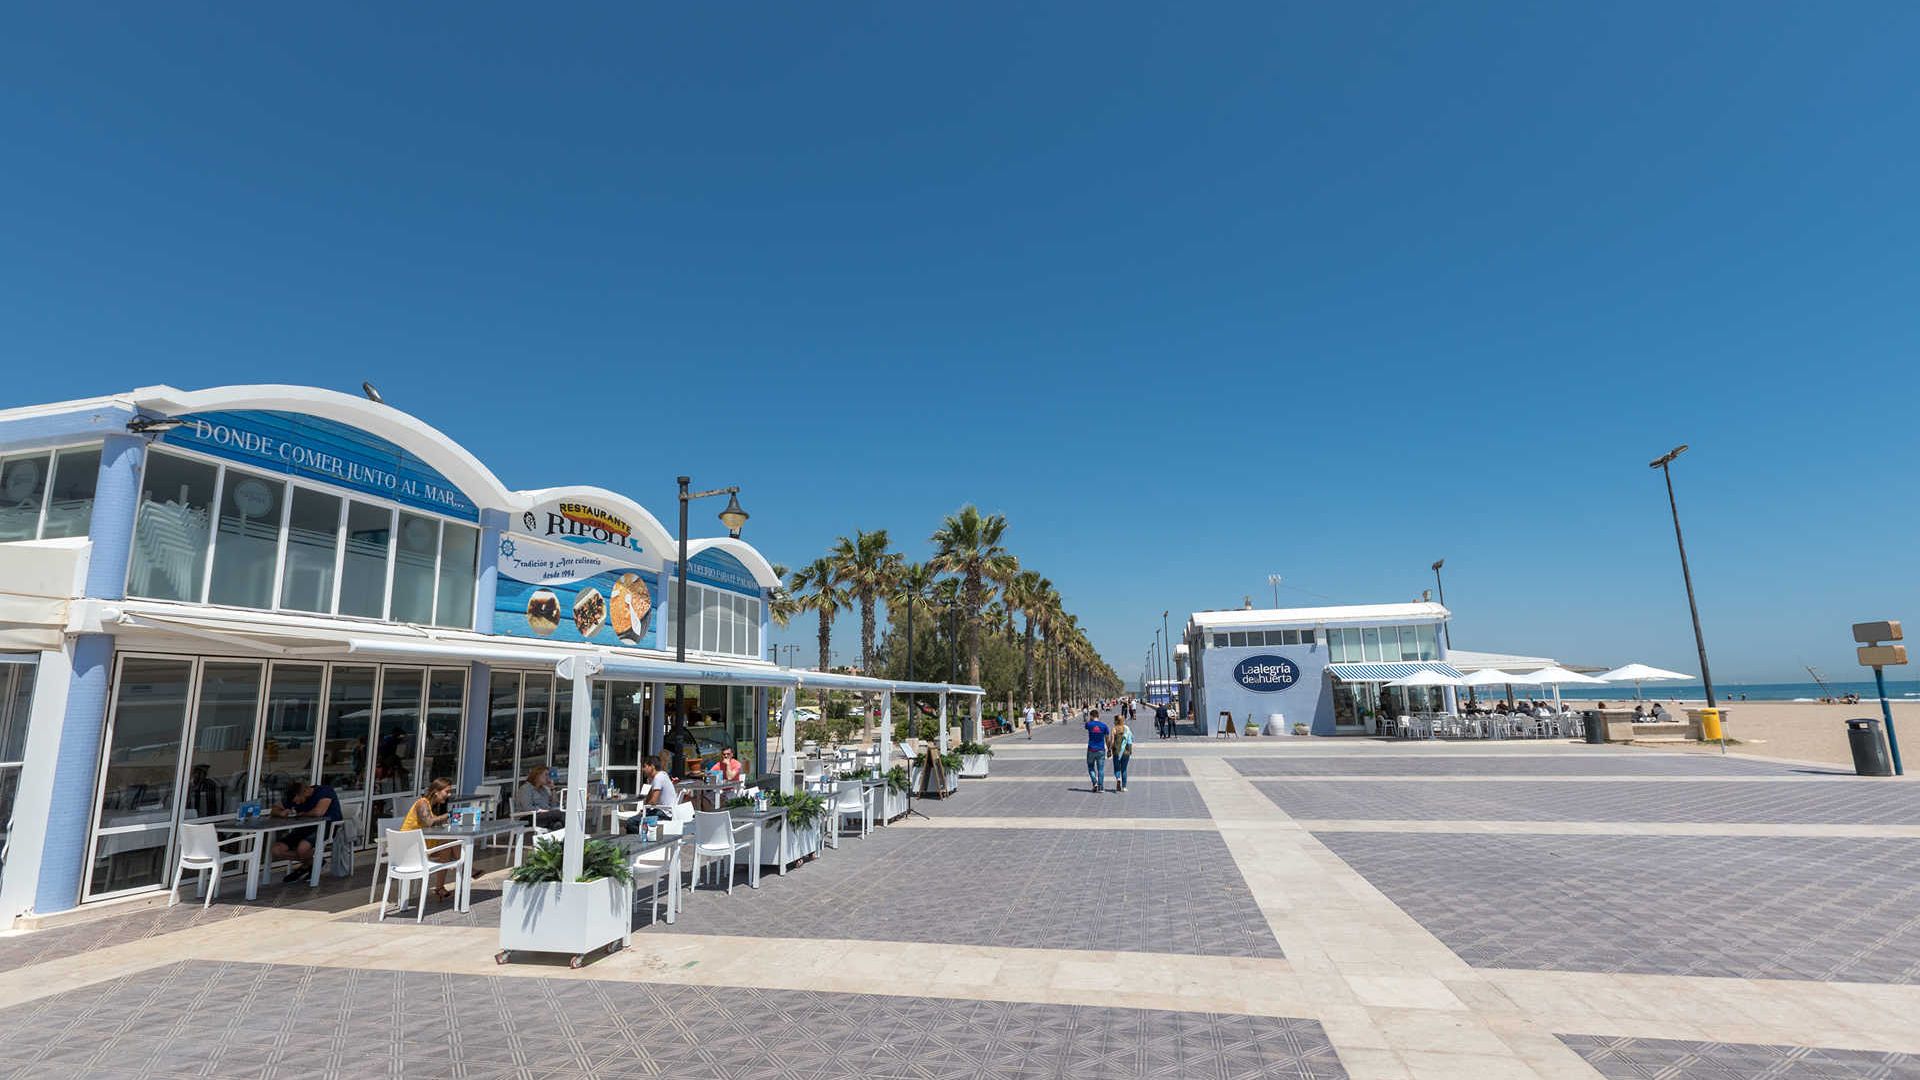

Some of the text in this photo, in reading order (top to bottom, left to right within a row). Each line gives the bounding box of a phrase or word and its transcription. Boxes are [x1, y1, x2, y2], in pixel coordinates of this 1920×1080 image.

[195, 420, 273, 455] DONDE
[279, 442, 343, 476] COMER
[346, 461, 397, 489] JUNTO
[401, 480, 420, 498] AL
[545, 512, 632, 549] RIPOLL
[559, 503, 632, 534] RESTAURANTE
[513, 559, 547, 569] Tradición
[543, 571, 560, 579] desde
